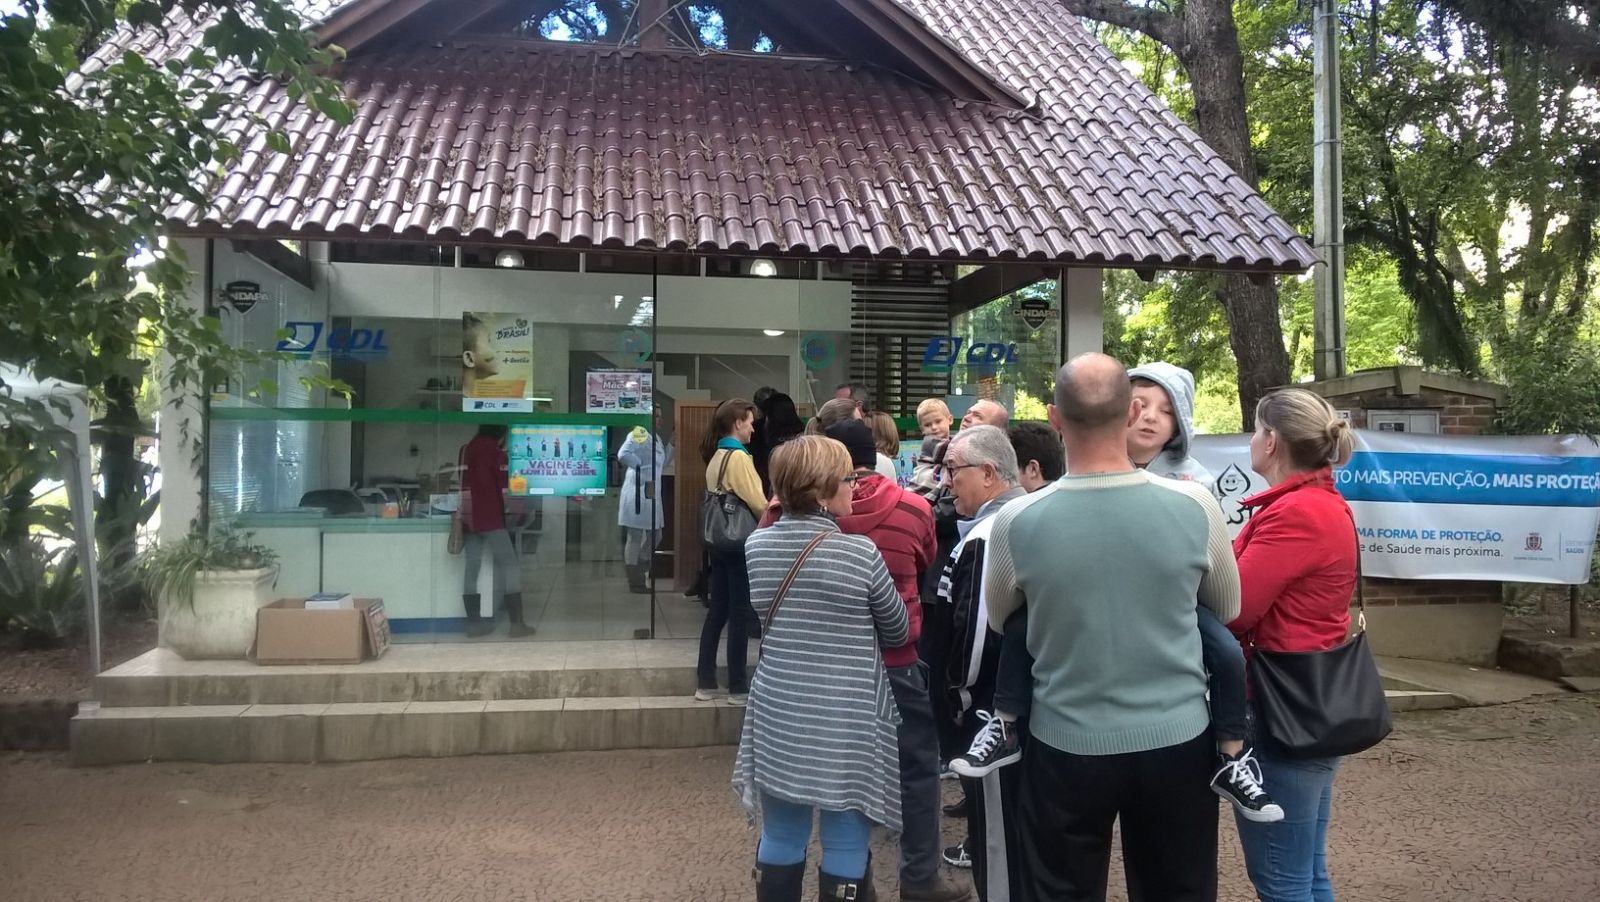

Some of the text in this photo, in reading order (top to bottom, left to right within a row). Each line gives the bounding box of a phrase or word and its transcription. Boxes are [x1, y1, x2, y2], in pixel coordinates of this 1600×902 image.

[327, 328, 388, 349] CDL
[966, 342, 1020, 362] CDL
[529, 460, 591, 470] VACINE-SE
[1332, 469, 1600, 493] TO MAIS PREVENÇÃO, MAIS PROTEÇÃ
[1357, 527, 1504, 543] MA FORMA DE PROTEÇÃO.
[1368, 542, 1384, 553] de
[1386, 543, 1422, 554] Saúde
[1424, 545, 1451, 555] mais
[1453, 546, 1504, 558] próxima.
